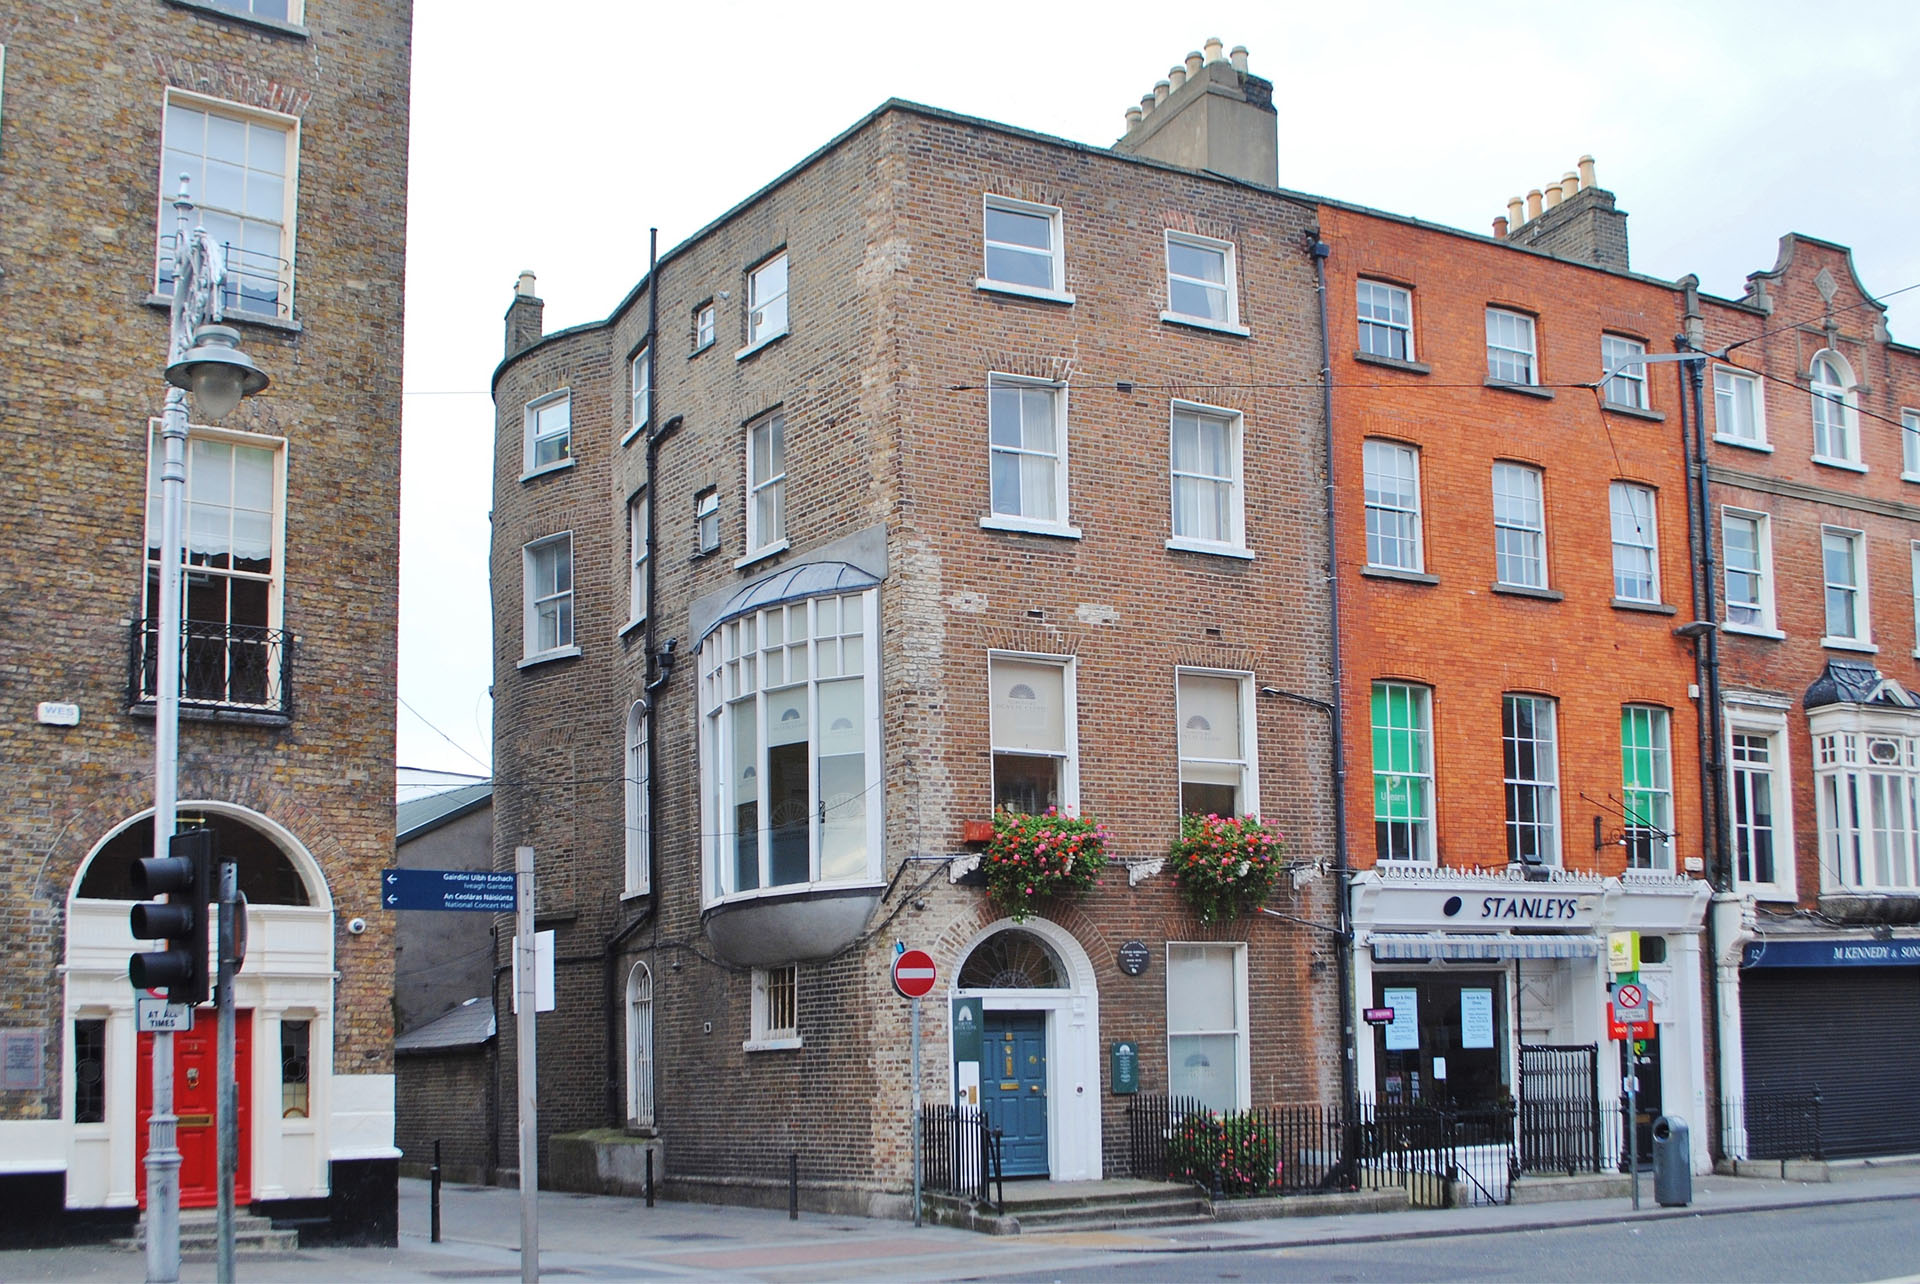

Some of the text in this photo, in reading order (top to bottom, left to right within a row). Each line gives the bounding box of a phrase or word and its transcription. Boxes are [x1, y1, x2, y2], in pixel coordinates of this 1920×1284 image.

[487, 874, 514, 882] Eachach
[463, 882, 486, 890] Iveagh
[1481, 897, 1577, 919] STANLEYS
[1833, 946, 1843, 959] M
[1844, 946, 1889, 959] KENNEDY
[1890, 949, 1898, 958] &
[150, 1020, 176, 1028] TIMES
